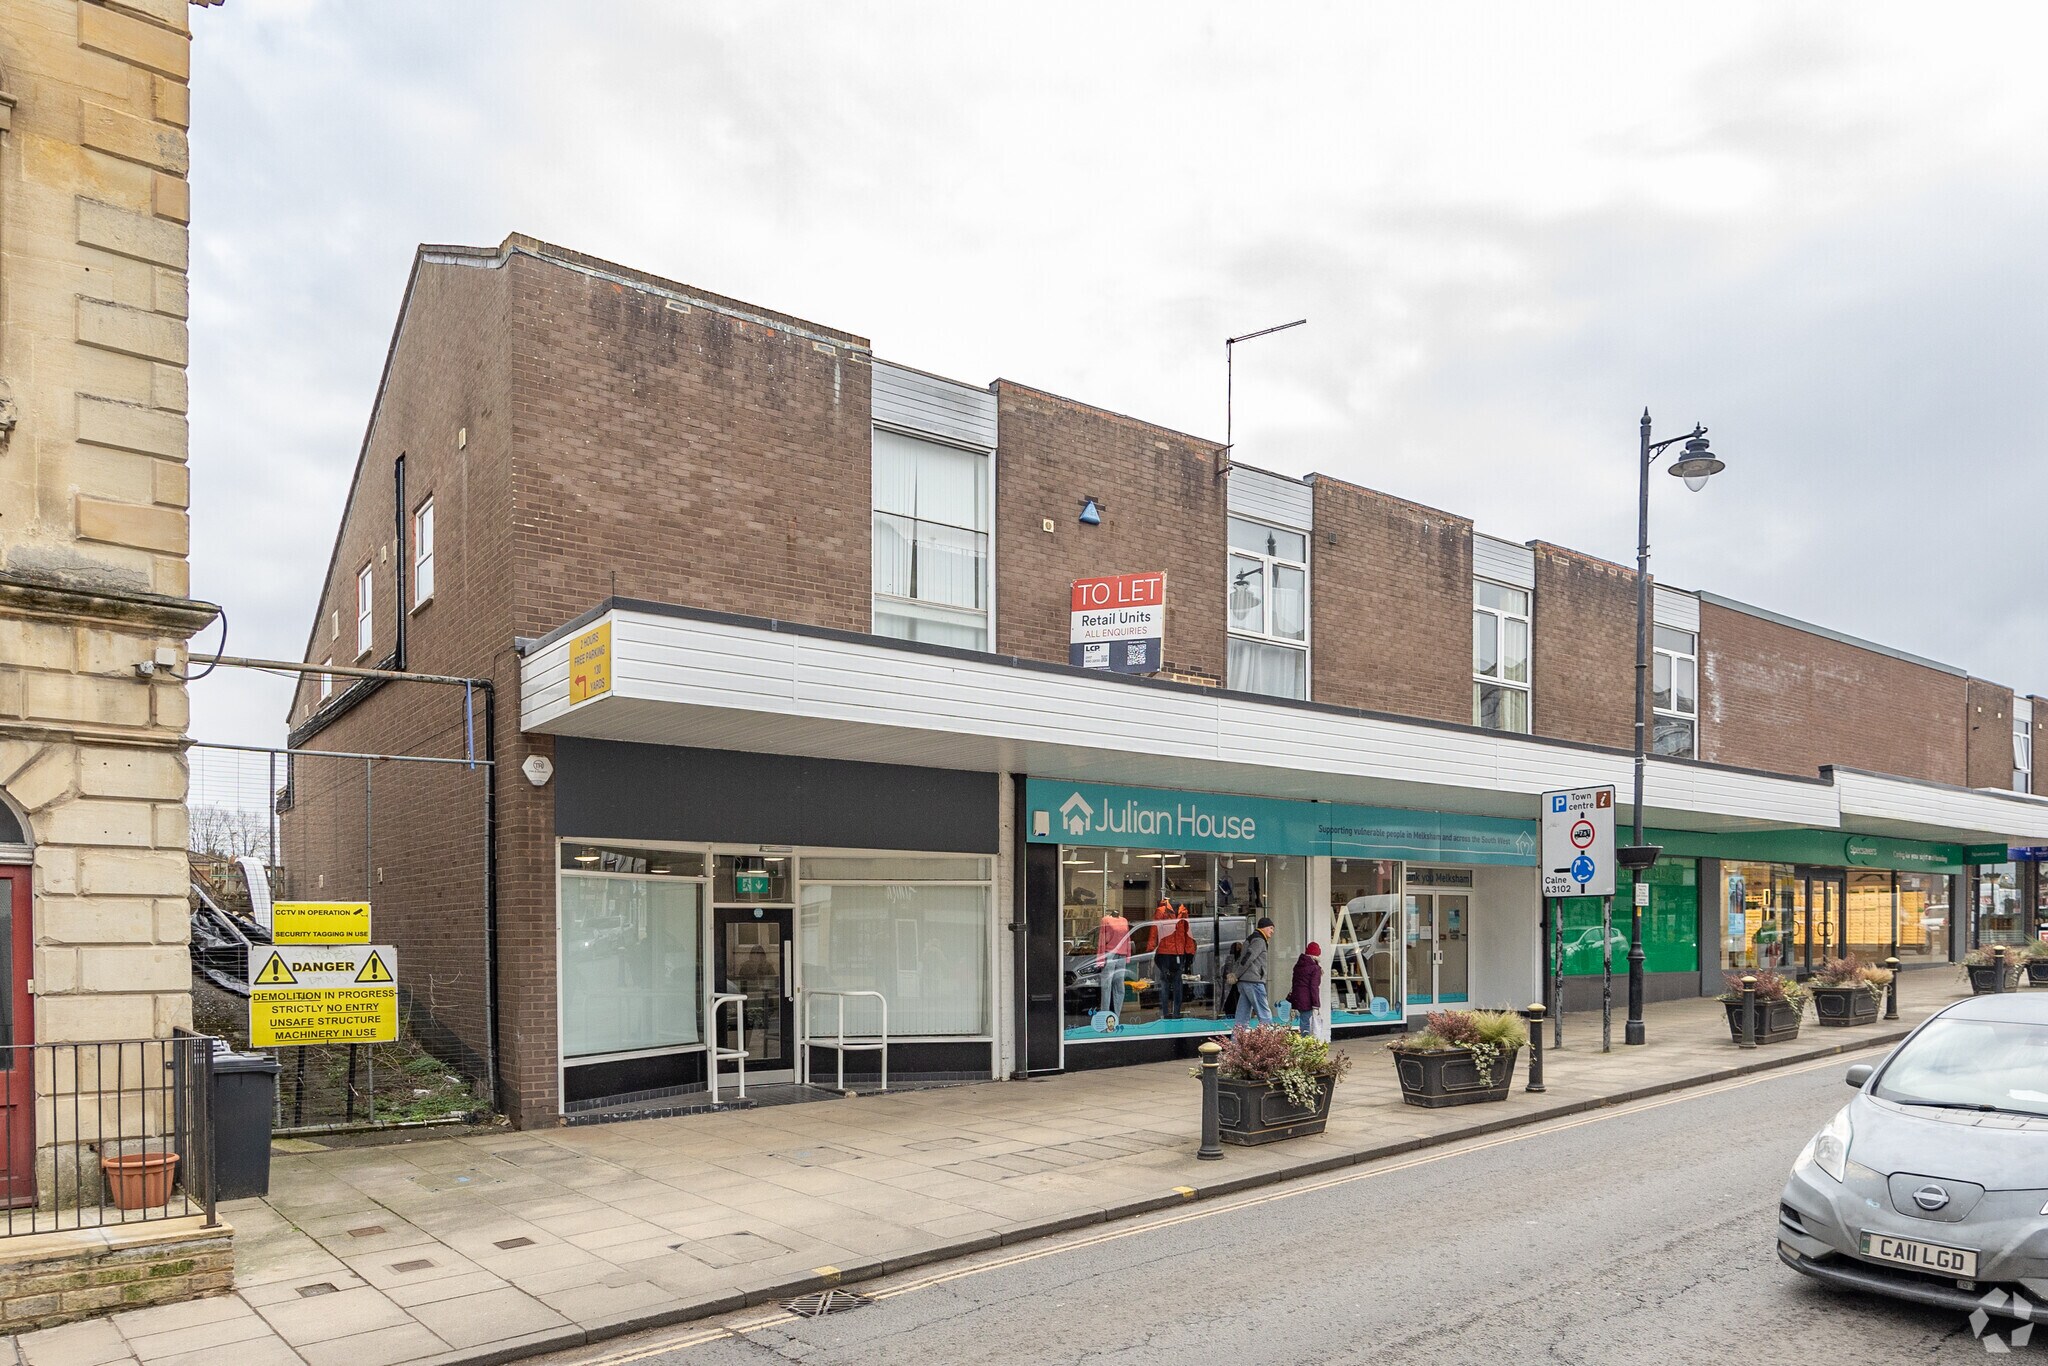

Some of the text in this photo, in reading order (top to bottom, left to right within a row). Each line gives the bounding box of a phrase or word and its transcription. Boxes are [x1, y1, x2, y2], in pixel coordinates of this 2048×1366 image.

[1077, 577, 1160, 605] TO LET
[1082, 611, 1151, 627] Retail Units
[1085, 626, 1148, 638] ALL ENQUIRIES
[584, 632, 599, 648] HOURS
[574, 645, 605, 668] FREE PARKING
[590, 678, 605, 692] YARDS
[1571, 793, 1592, 801] Town
[1569, 802, 1594, 811] centre
[1095, 798, 1256, 840] Julian House
[1318, 824, 1511, 845] Supporting vulnerable people in Melksham and across the South West
[1422, 873, 1433, 884] you
[1436, 873, 1469, 883] Melksham
[1545, 876, 1567, 884] Calne
[292, 962, 355, 972] DANGER
[253, 990, 395, 1001] DEMOLITION IN PROGRESS
[272, 1003, 379, 1013] STRICTLY NO ENTRY
[270, 1016, 381, 1027] UNSAFE STRUCTURE
[275, 1028, 376, 1039] MACHINERY IN USE
[1881, 1239, 1964, 1271] CA11 LGD
